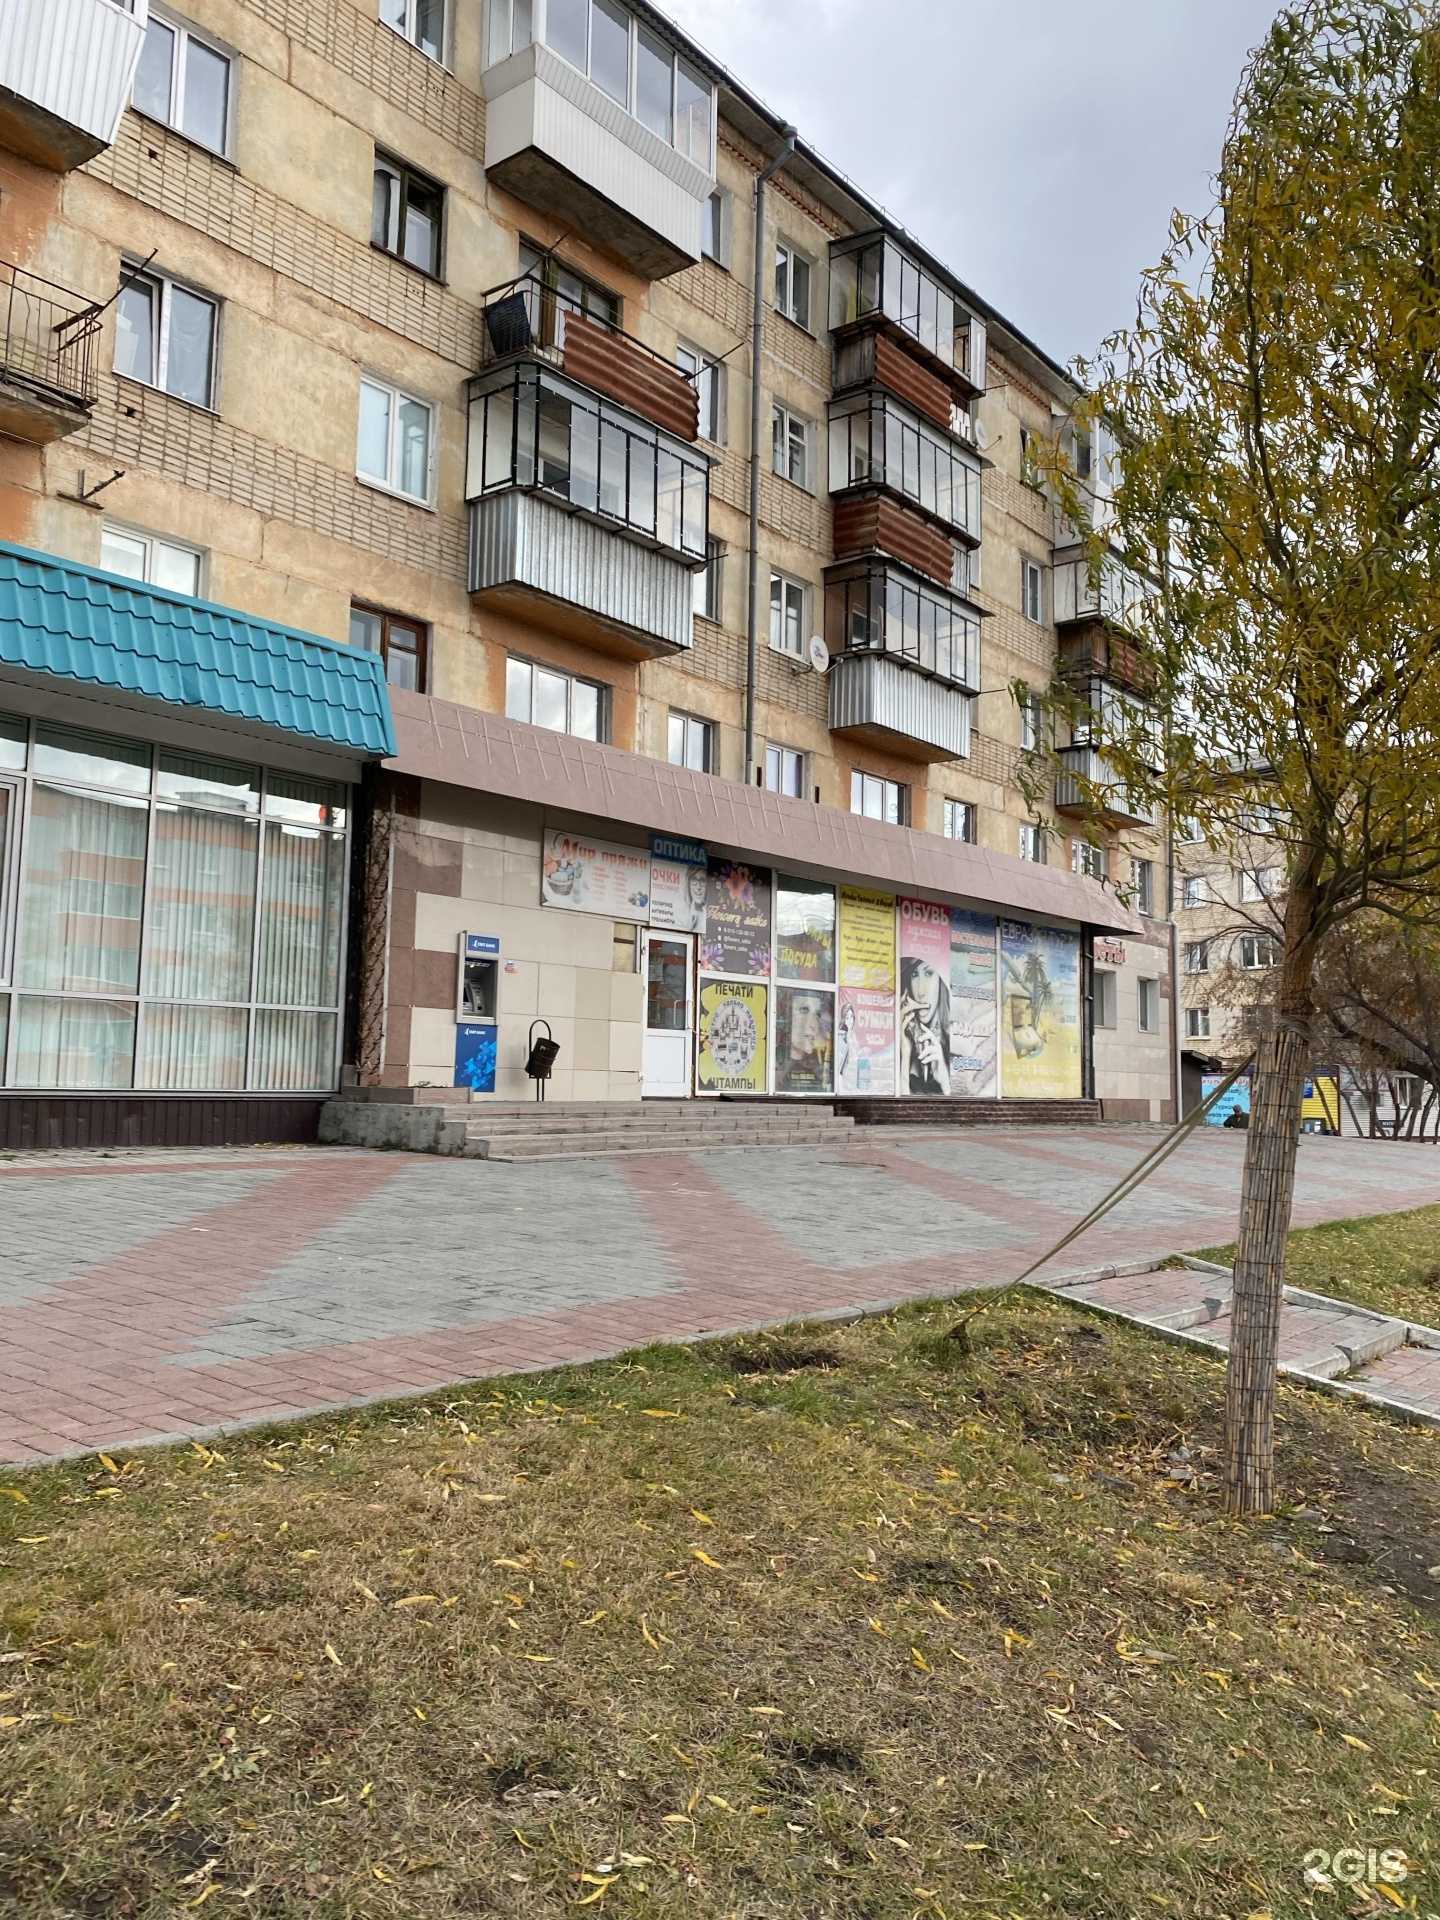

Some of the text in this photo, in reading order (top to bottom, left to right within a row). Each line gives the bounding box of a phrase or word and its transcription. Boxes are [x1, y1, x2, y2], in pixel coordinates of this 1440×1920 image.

[560, 837, 596, 859] Мир
[653, 838, 706, 863] ОПТИКА
[652, 868, 680, 885] ОЧКИ
[901, 900, 949, 926] ОБУВЬ
[782, 947, 817, 968] ПОСУДА
[715, 982, 754, 999] ПЕЧАТИ
